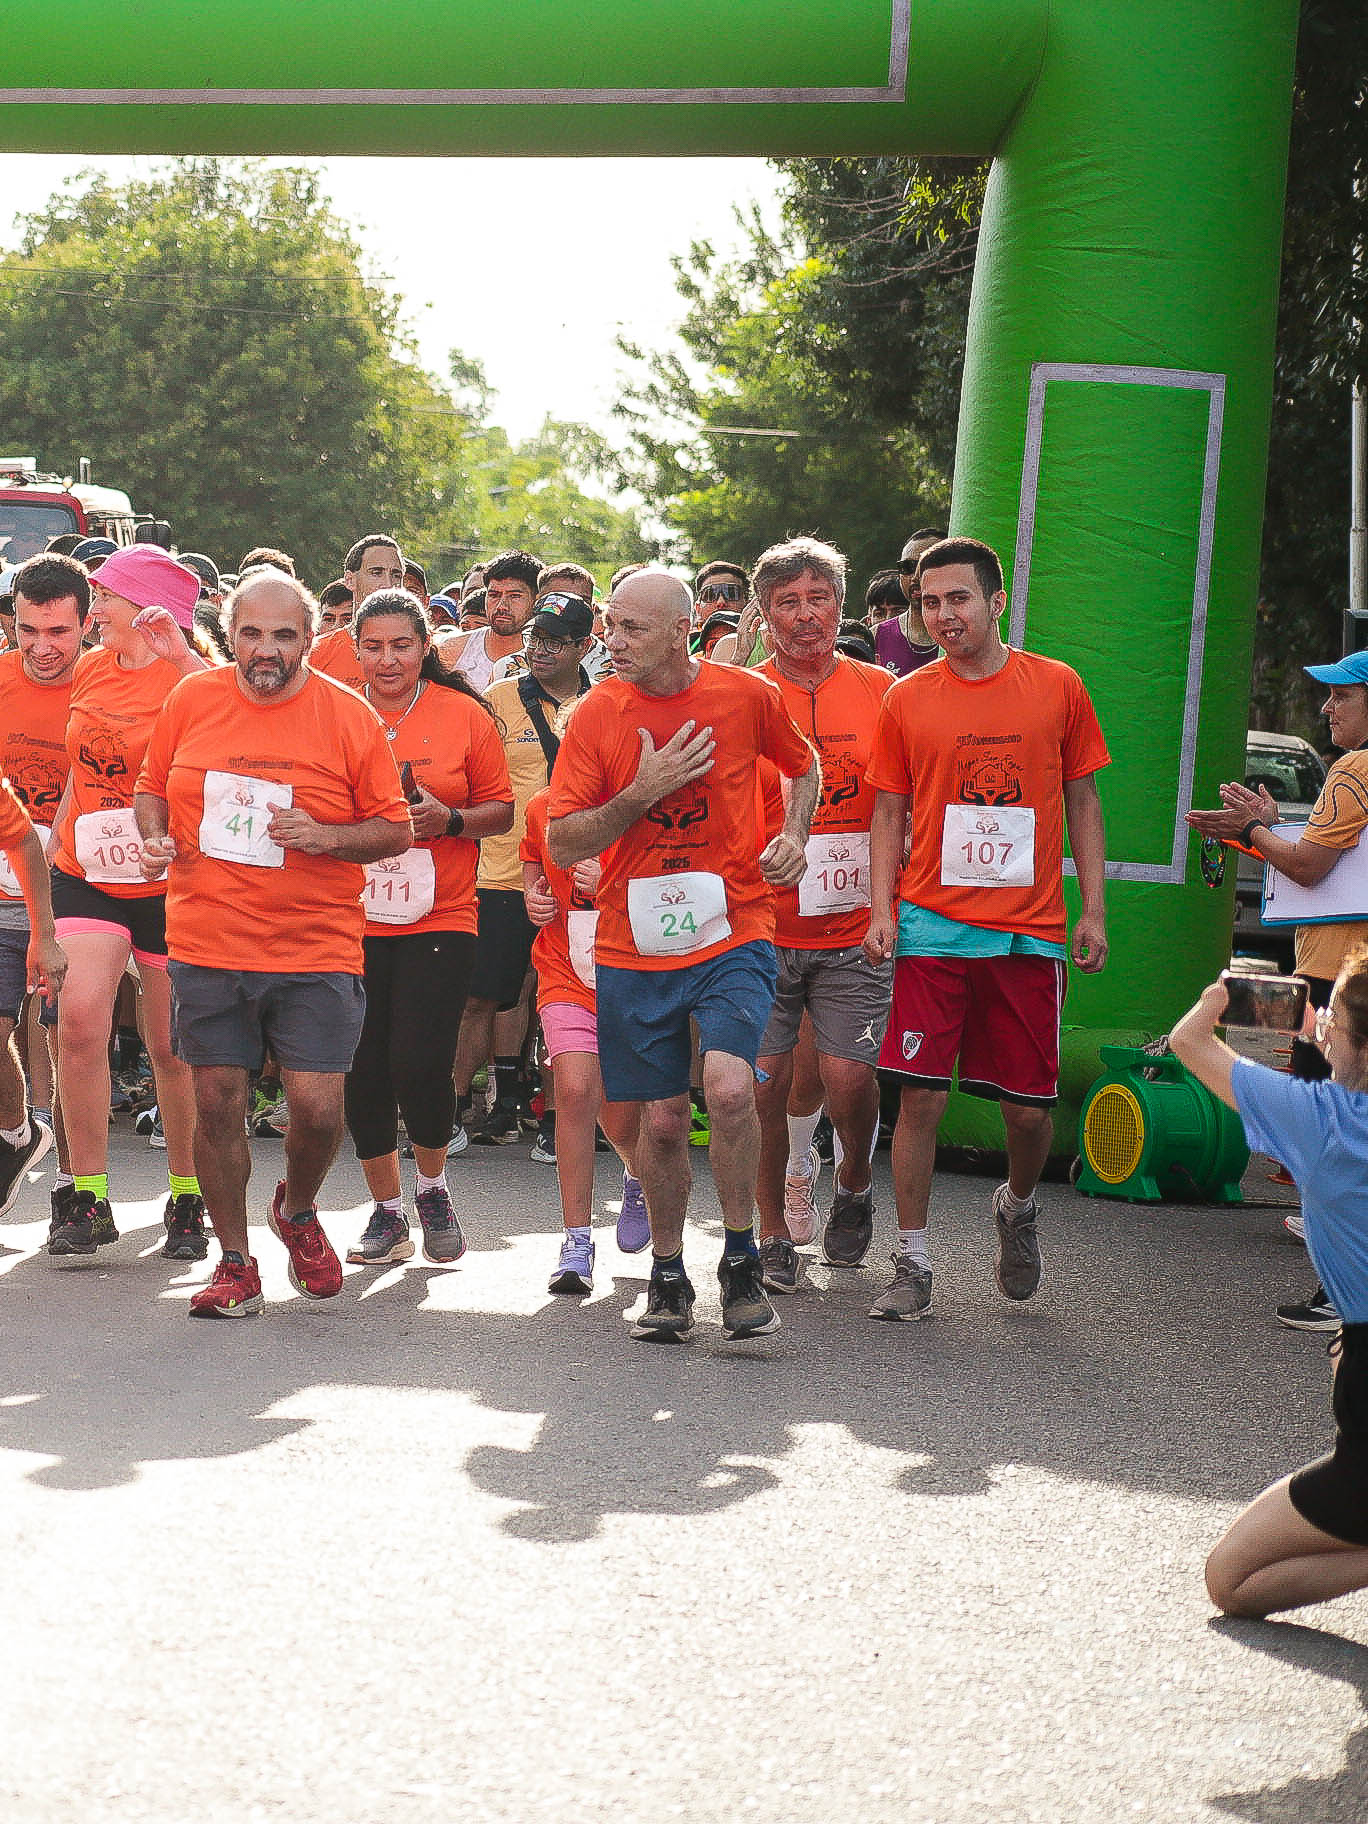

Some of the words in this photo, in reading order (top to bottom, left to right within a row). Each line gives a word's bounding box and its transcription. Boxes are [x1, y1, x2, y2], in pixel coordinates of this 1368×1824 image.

[224, 813, 253, 840] 41
[94, 842, 142, 868] 103
[961, 840, 1014, 866] 107
[365, 877, 411, 903] 111
[816, 867, 861, 892] 101
[660, 911, 699, 938] 24
